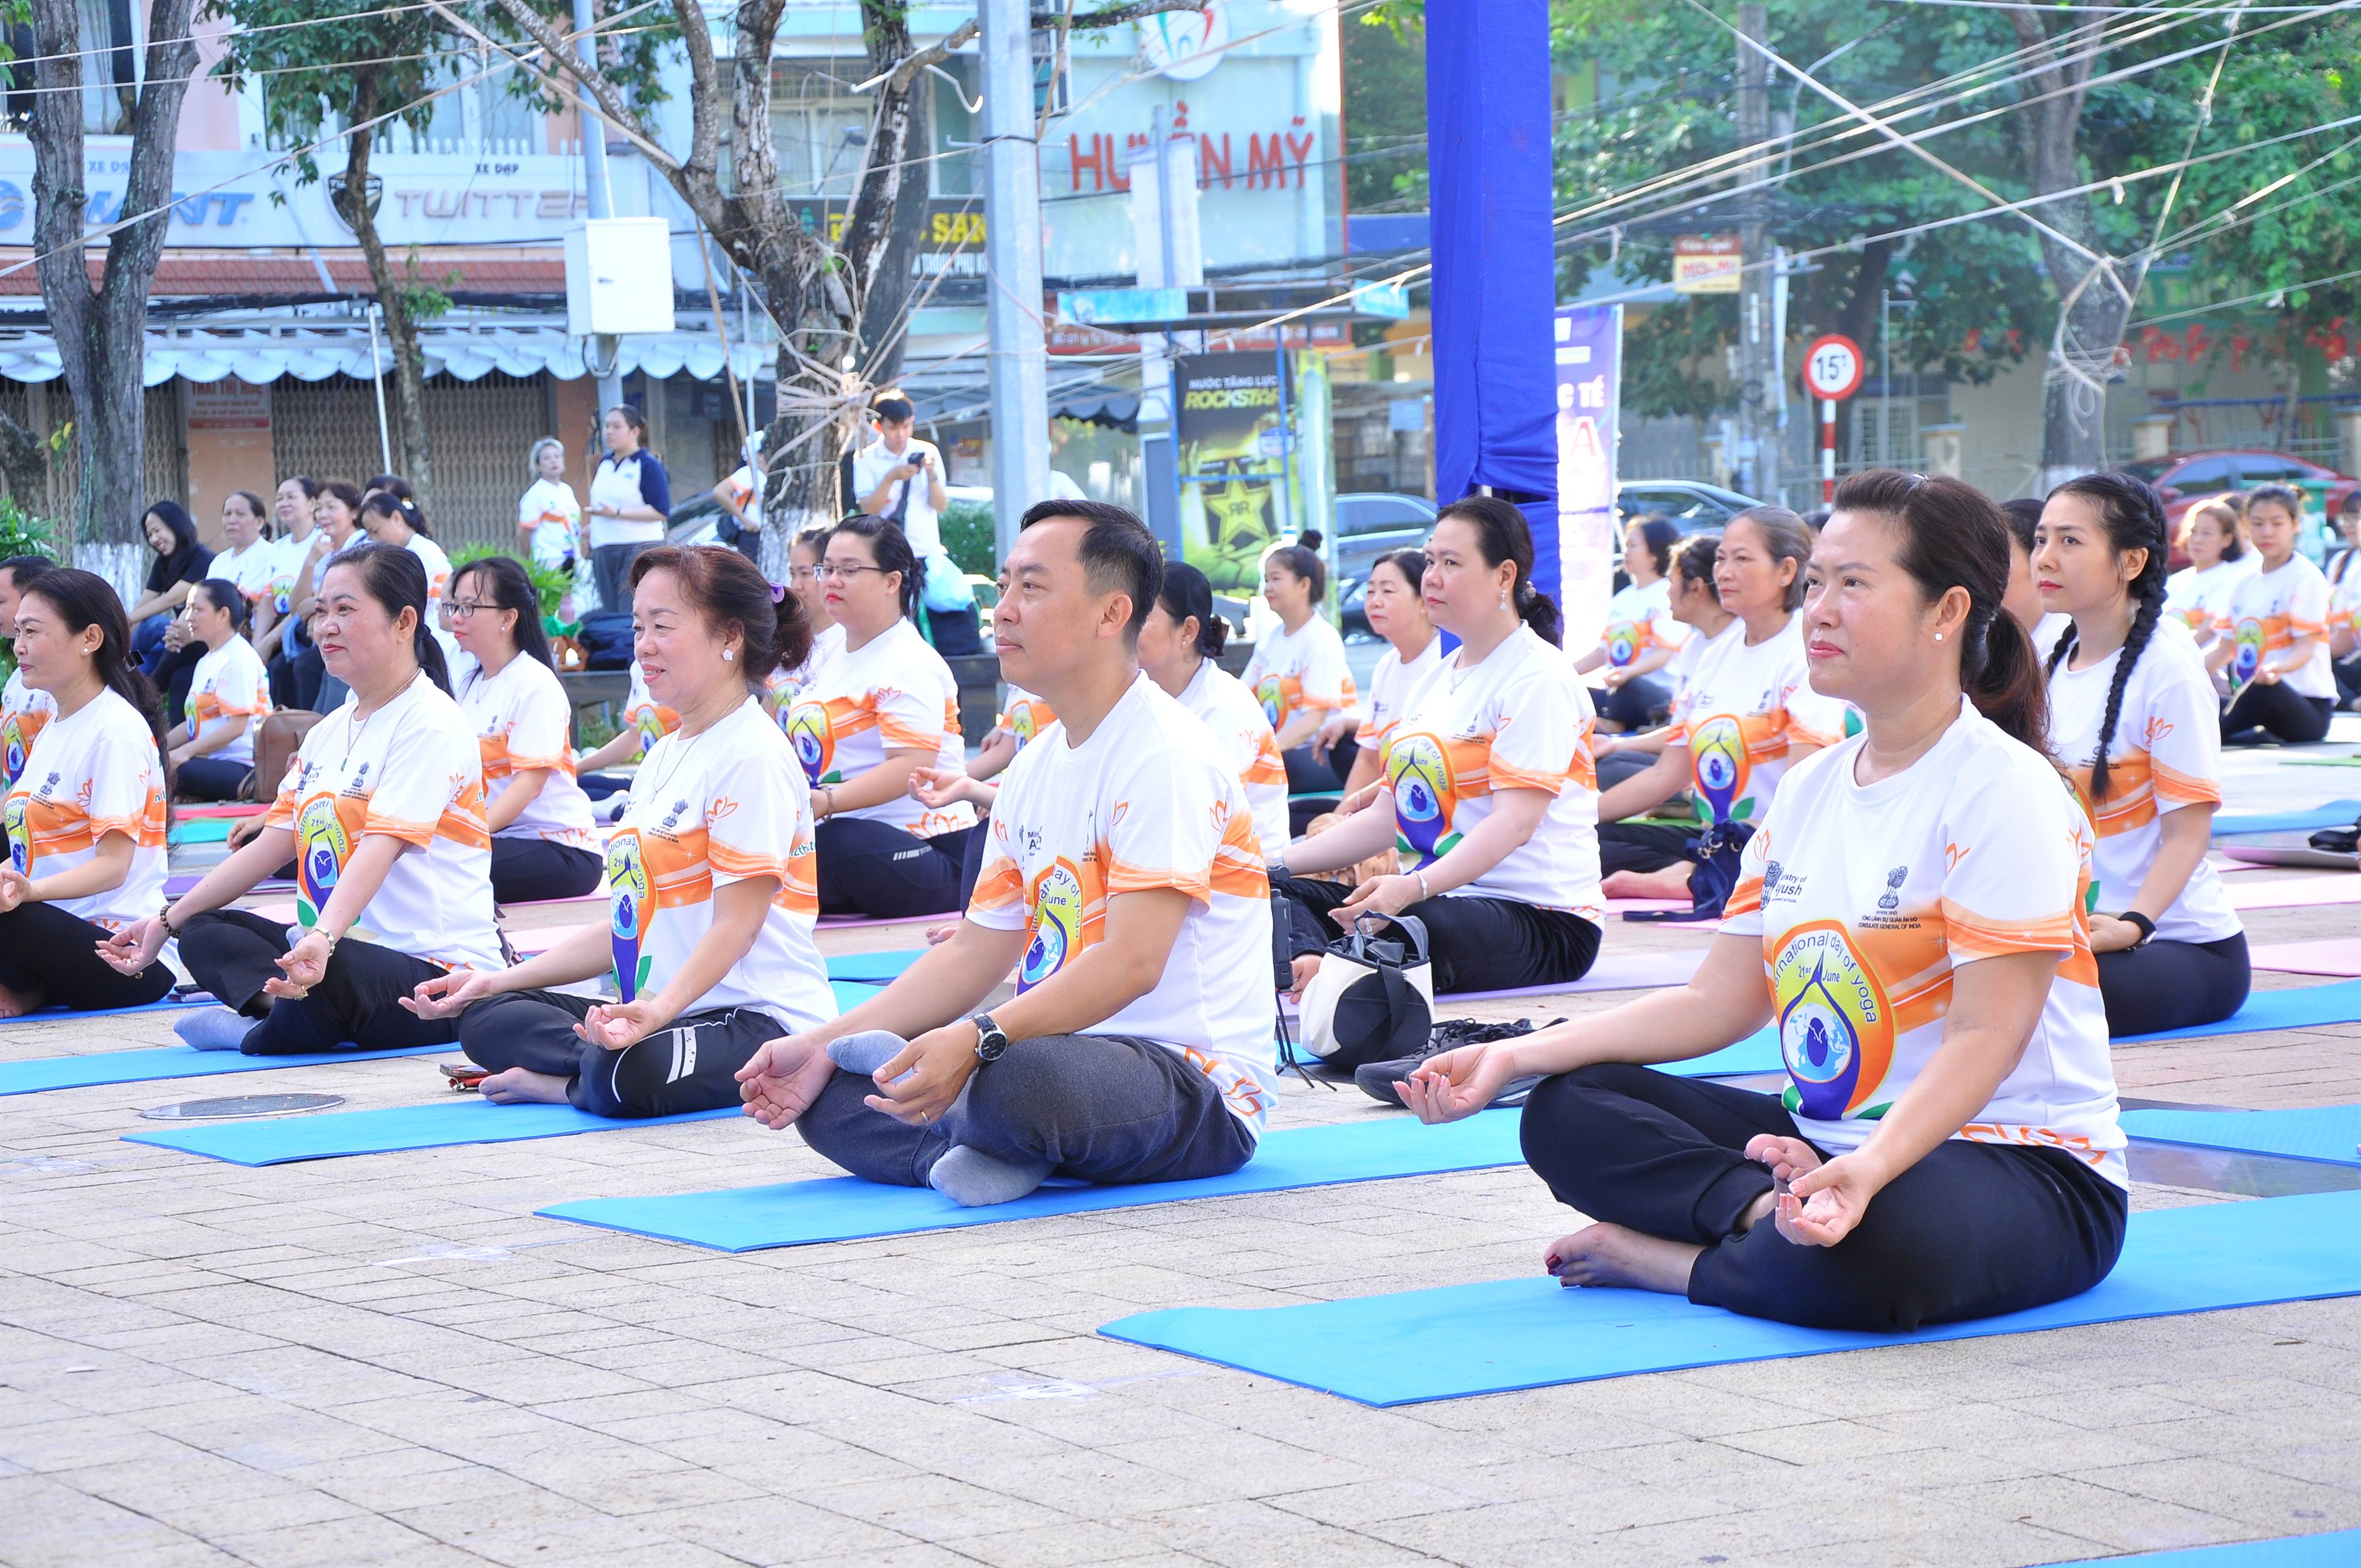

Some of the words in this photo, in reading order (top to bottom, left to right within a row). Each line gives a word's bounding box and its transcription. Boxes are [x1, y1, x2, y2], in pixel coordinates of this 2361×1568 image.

[1048, 895, 1066, 906] une
[1798, 965, 1812, 978] 21st
[1822, 969, 1840, 982] June
[1830, 934, 1844, 958] day
[1843, 955, 1857, 972] of
[1851, 974, 1877, 1023] yoga
